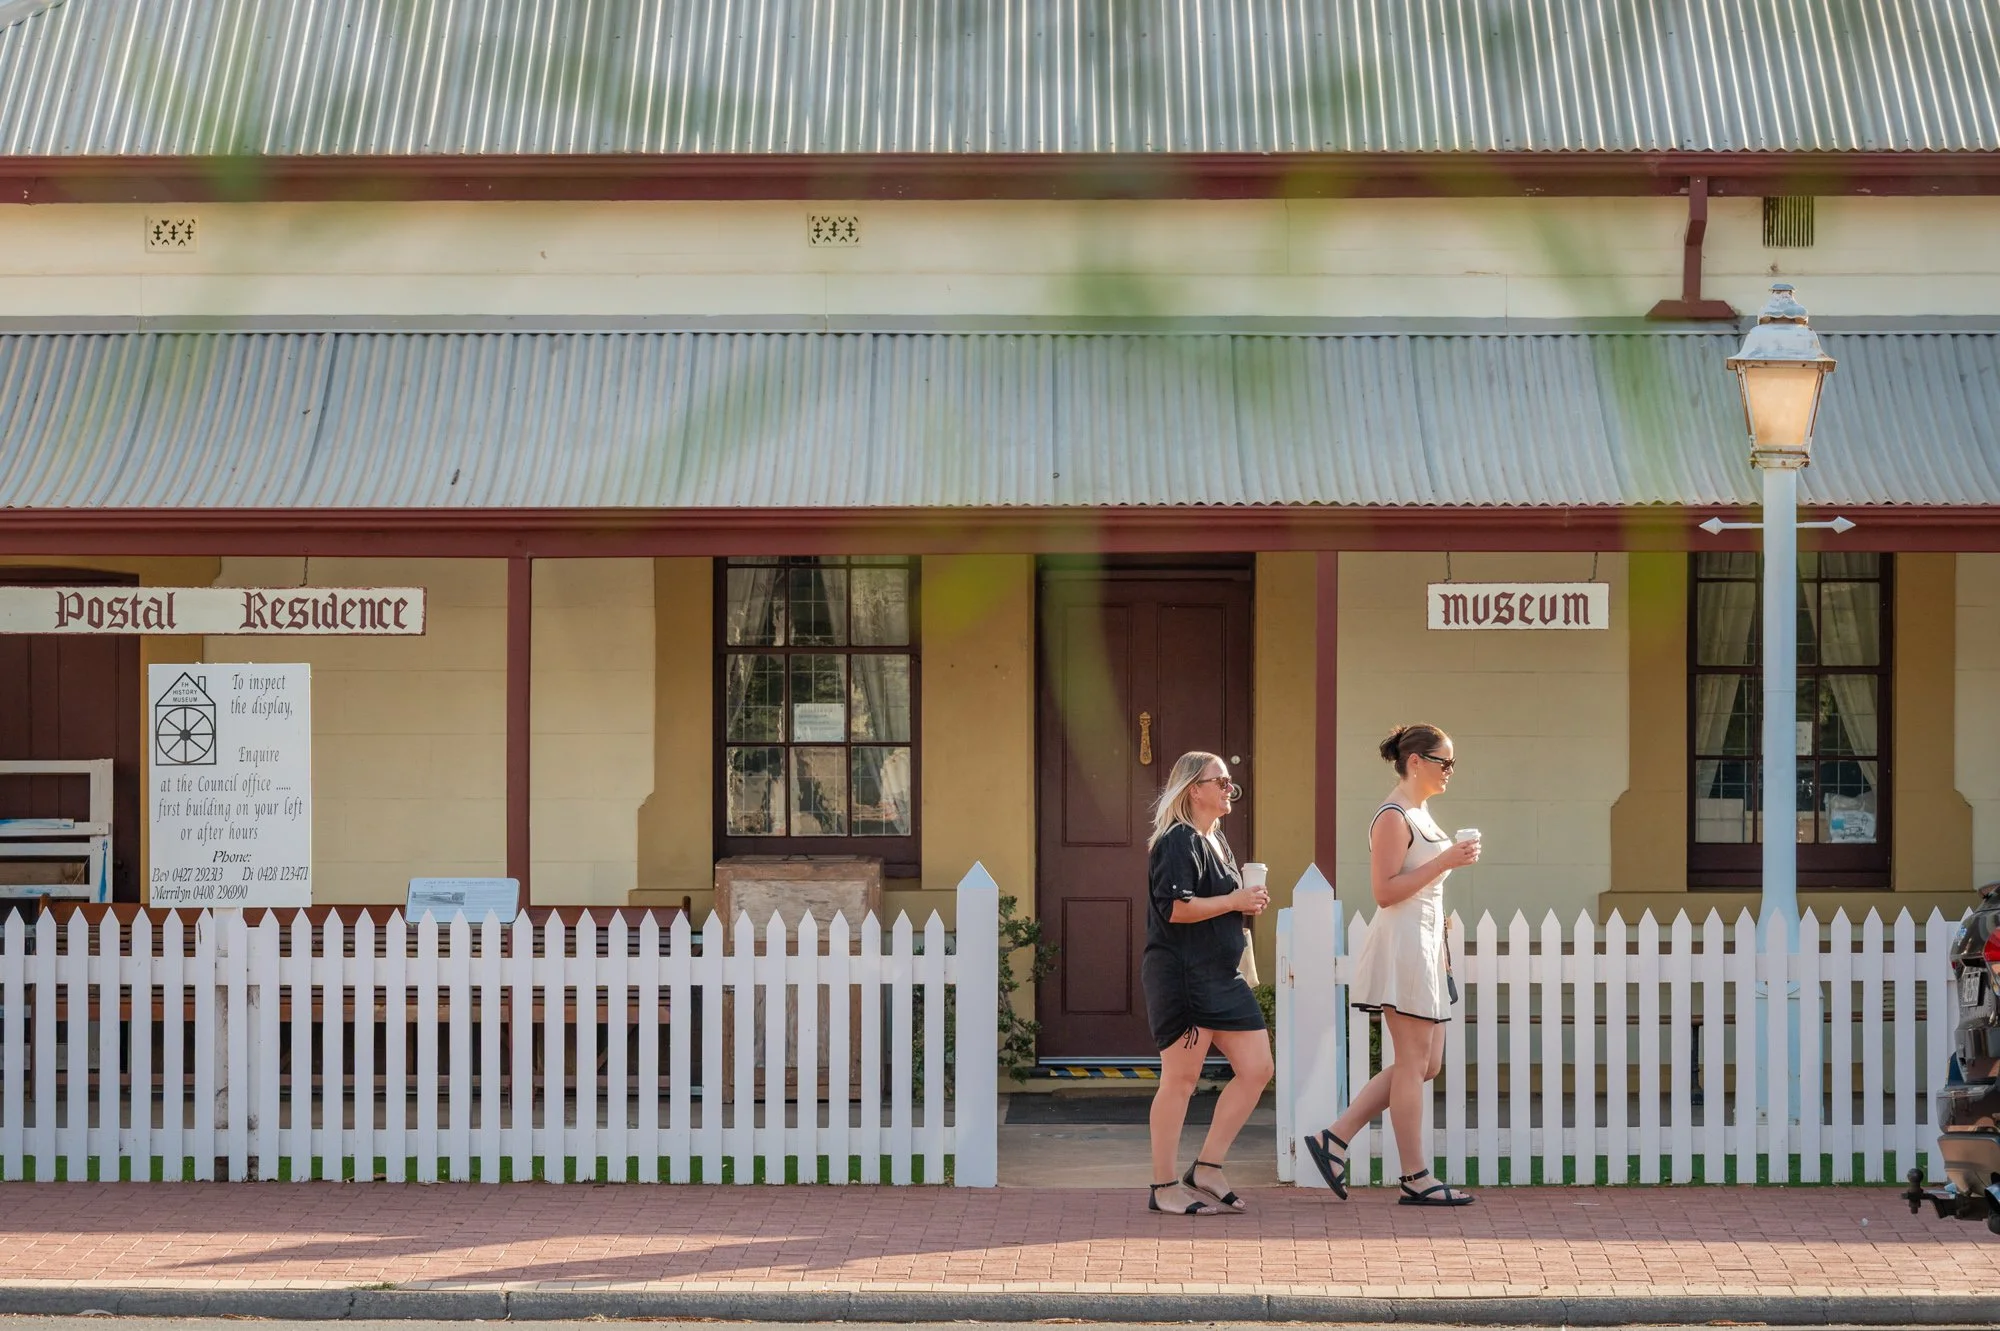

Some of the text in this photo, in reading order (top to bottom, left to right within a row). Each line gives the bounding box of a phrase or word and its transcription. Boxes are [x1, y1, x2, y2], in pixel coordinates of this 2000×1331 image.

[54, 590, 408, 631] Postal Residence
[232, 673, 286, 696] To inspect
[230, 695, 293, 720] the display,
[238, 746, 280, 768] Enquire
[160, 777, 171, 792] at
[176, 773, 193, 792] the
[198, 773, 239, 792] Council
[242, 773, 271, 798] office
[156, 796, 303, 822] first building on your left
[180, 821, 258, 847] or after hours
[212, 850, 252, 863] Phone:
[152, 867, 224, 883] Bev 0427 292313
[242, 866, 309, 881] Di 0428 123471
[152, 884, 248, 902] Merrilyn 0408 296990
